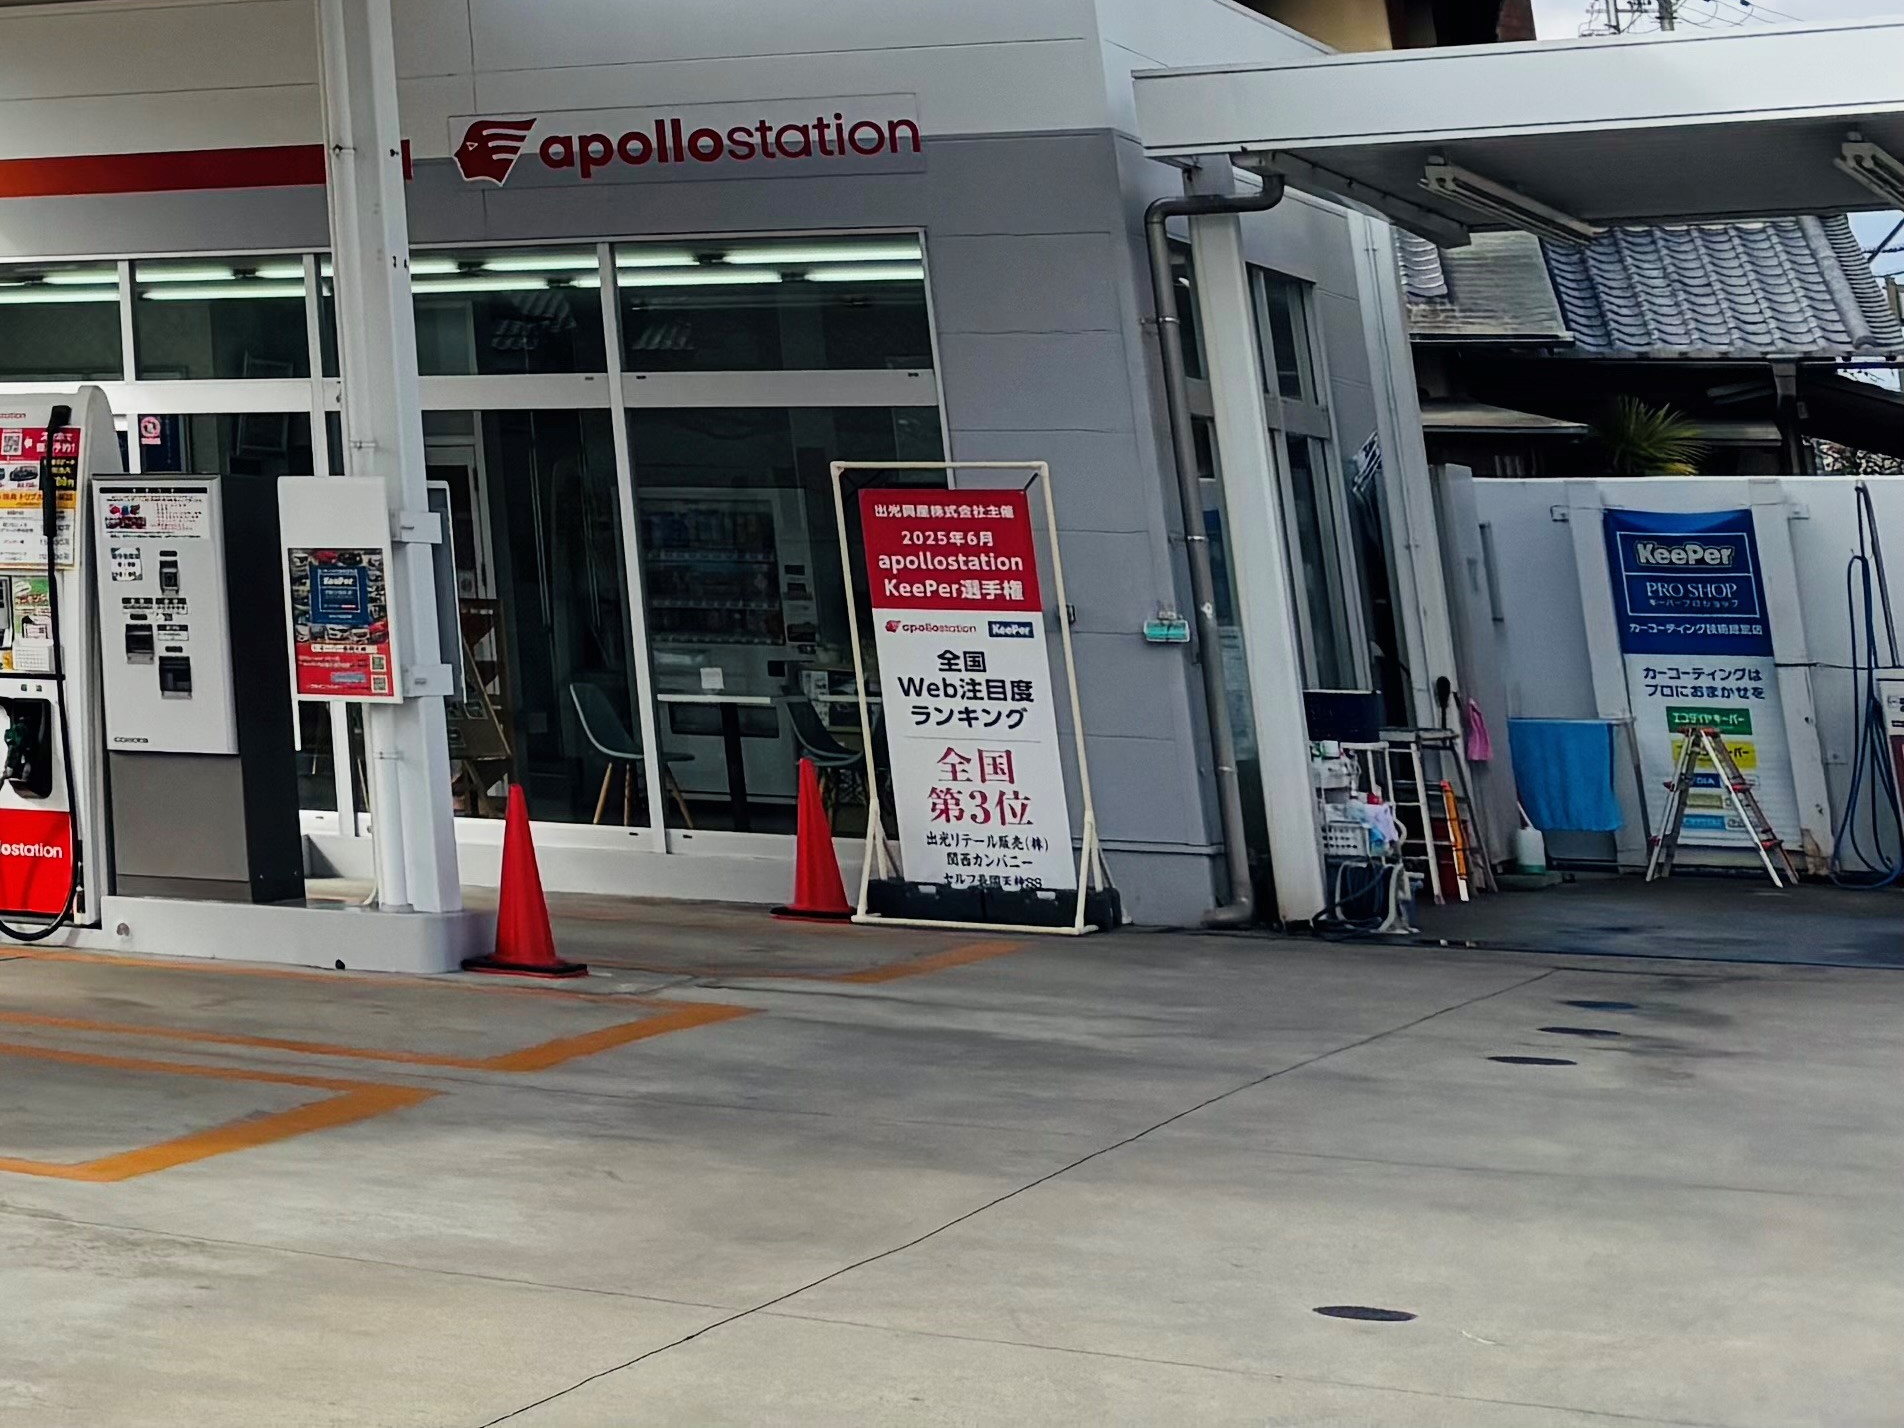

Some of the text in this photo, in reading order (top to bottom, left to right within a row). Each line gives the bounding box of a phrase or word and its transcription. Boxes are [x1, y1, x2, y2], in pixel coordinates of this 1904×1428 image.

[539, 113, 920, 178] apollostation
[874, 504, 1014, 519] 出光興産株式会社主催
[901, 531, 994, 546] 2025年6月
[878, 552, 1023, 574] apollostation
[1635, 542, 1735, 567] KeePer
[884, 579, 1025, 600] KeePer選手権
[1646, 582, 1737, 598] PRO SHOP
[902, 622, 1031, 636] apollostation KeePer
[937, 649, 987, 673] 全国
[1643, 667, 1763, 682] カーコーティングは
[897, 676, 1035, 703] Web注目度
[1645, 684, 1766, 700] プロにおまかせを
[911, 705, 1028, 729] ランキング
[937, 746, 1015, 784] 全国
[927, 786, 1034, 826] 第3位
